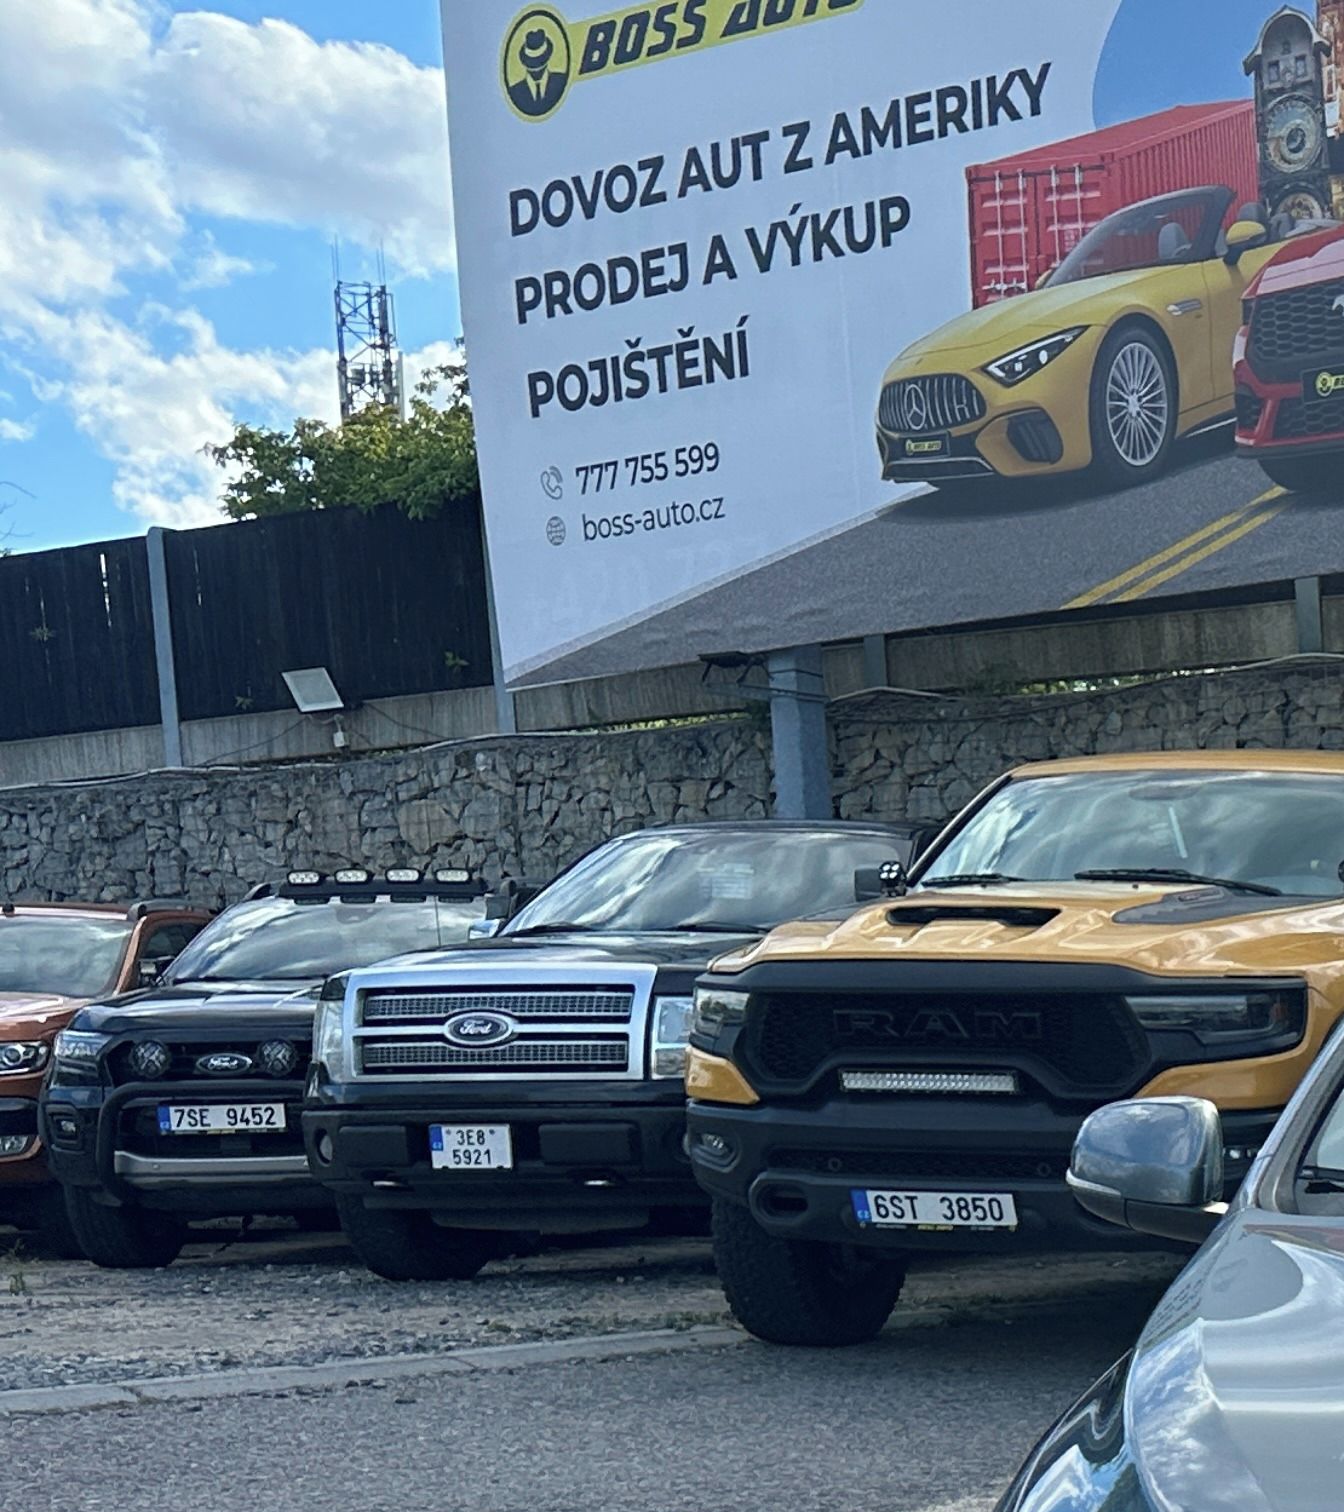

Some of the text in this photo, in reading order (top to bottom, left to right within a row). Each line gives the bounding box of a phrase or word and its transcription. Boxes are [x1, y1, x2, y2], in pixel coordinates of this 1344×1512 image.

[578, 0, 707, 75] BOSS
[509, 62, 1052, 237] DOVOZ AUT Z AMERIKY
[515, 196, 911, 325] PRODEJ A VÝKUP
[527, 315, 750, 419] POJIŠTĚNÍ
[575, 442, 720, 495] 777 755 599
[582, 497, 726, 541] boss-auto.cz
[459, 1019, 492, 1035] Ford
[833, 1009, 1042, 1039] RAM
[174, 1106, 277, 1128] 7SE 9452
[456, 1129, 486, 1146] 3E8
[452, 1148, 491, 1165] 5921
[874, 1194, 1004, 1222] 6ST 3850
